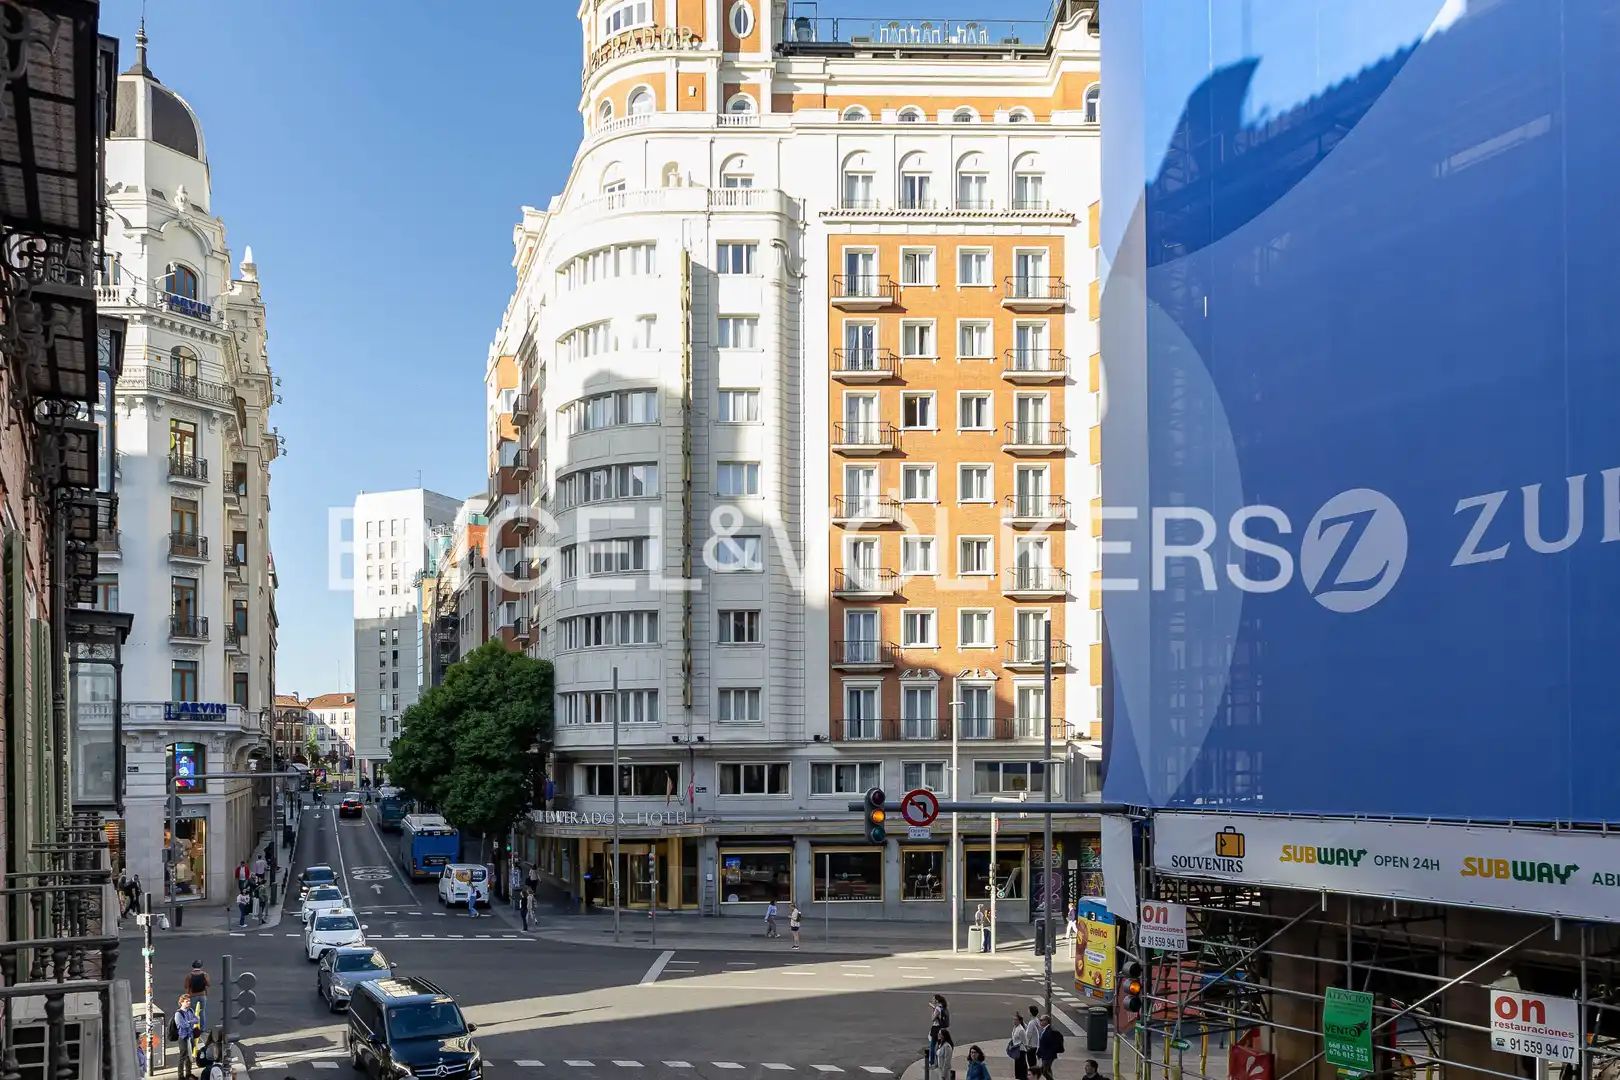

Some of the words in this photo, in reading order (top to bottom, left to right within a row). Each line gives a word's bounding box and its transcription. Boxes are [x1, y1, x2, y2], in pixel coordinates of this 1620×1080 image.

[546, 810, 626, 824] EMPERADOR
[637, 811, 692, 825] HOTEL
[1171, 854, 1243, 873] SOUVENIRS
[1279, 844, 1368, 867] SUBWAY
[1373, 854, 1409, 869] OPEN
[1412, 857, 1440, 871] 24H
[1460, 856, 1580, 885] SUBWAY
[1143, 905, 1168, 924] on
[1494, 996, 1545, 1025] on
[1494, 1021, 1575, 1039] restauraciones
[1510, 1038, 1521, 1050] 91
[1523, 1040, 1542, 1055] 559
[1545, 1043, 1559, 1058] 94
[1562, 1046, 1574, 1060] 07
